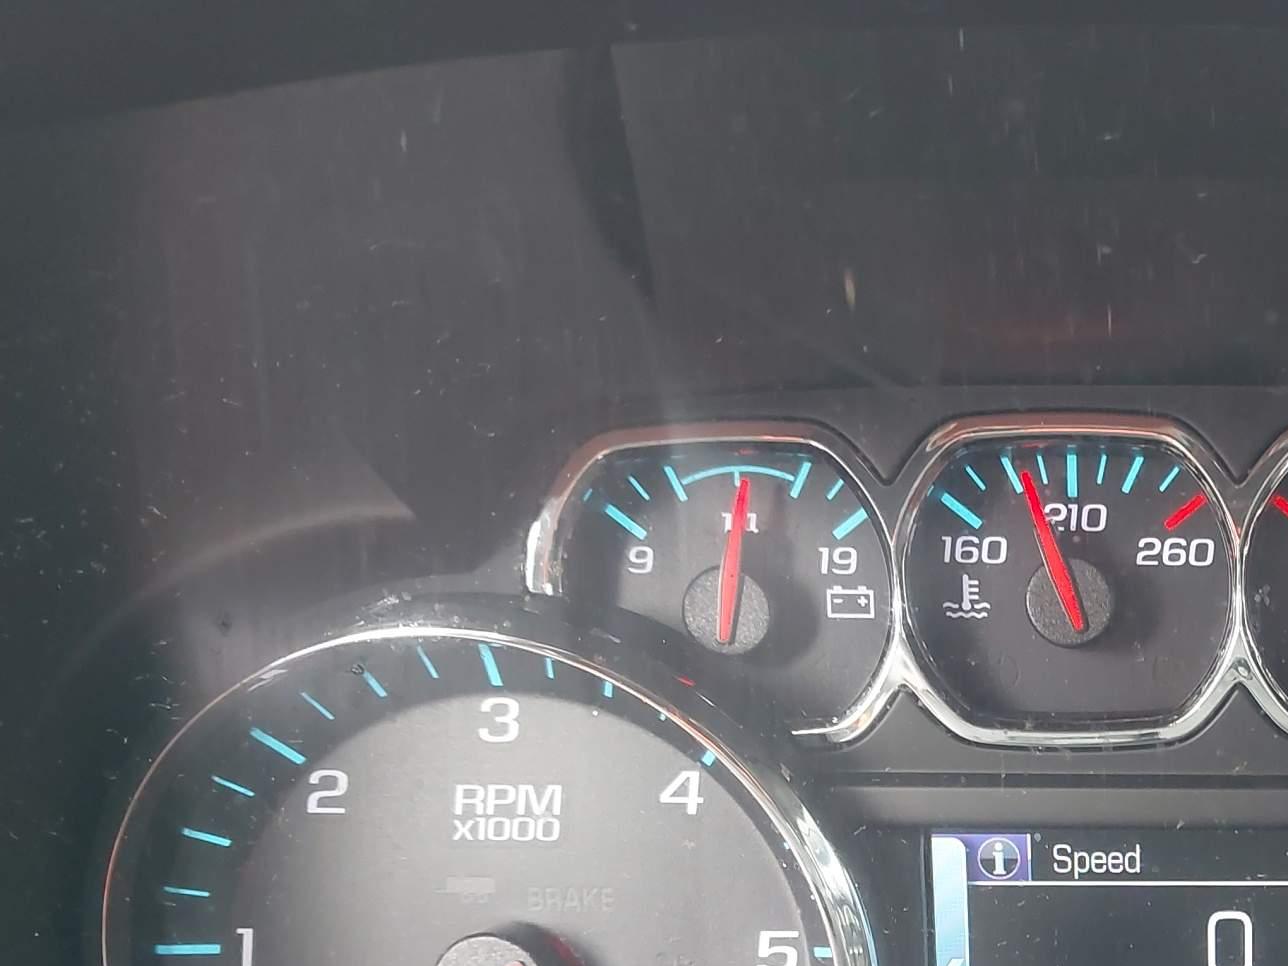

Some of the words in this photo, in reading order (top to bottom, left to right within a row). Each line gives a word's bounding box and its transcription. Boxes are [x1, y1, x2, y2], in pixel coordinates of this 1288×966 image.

[1044, 503, 1108, 532] 210
[628, 547, 654, 574] 9
[818, 547, 858, 575] 19
[942, 535, 1008, 564] 160
[1136, 537, 1215, 567] 260
[478, 698, 520, 743] 3
[307, 769, 349, 814] 2
[453, 784, 563, 815] RPM
[659, 770, 704, 815] 4
[1052, 844, 1141, 876] Speed
